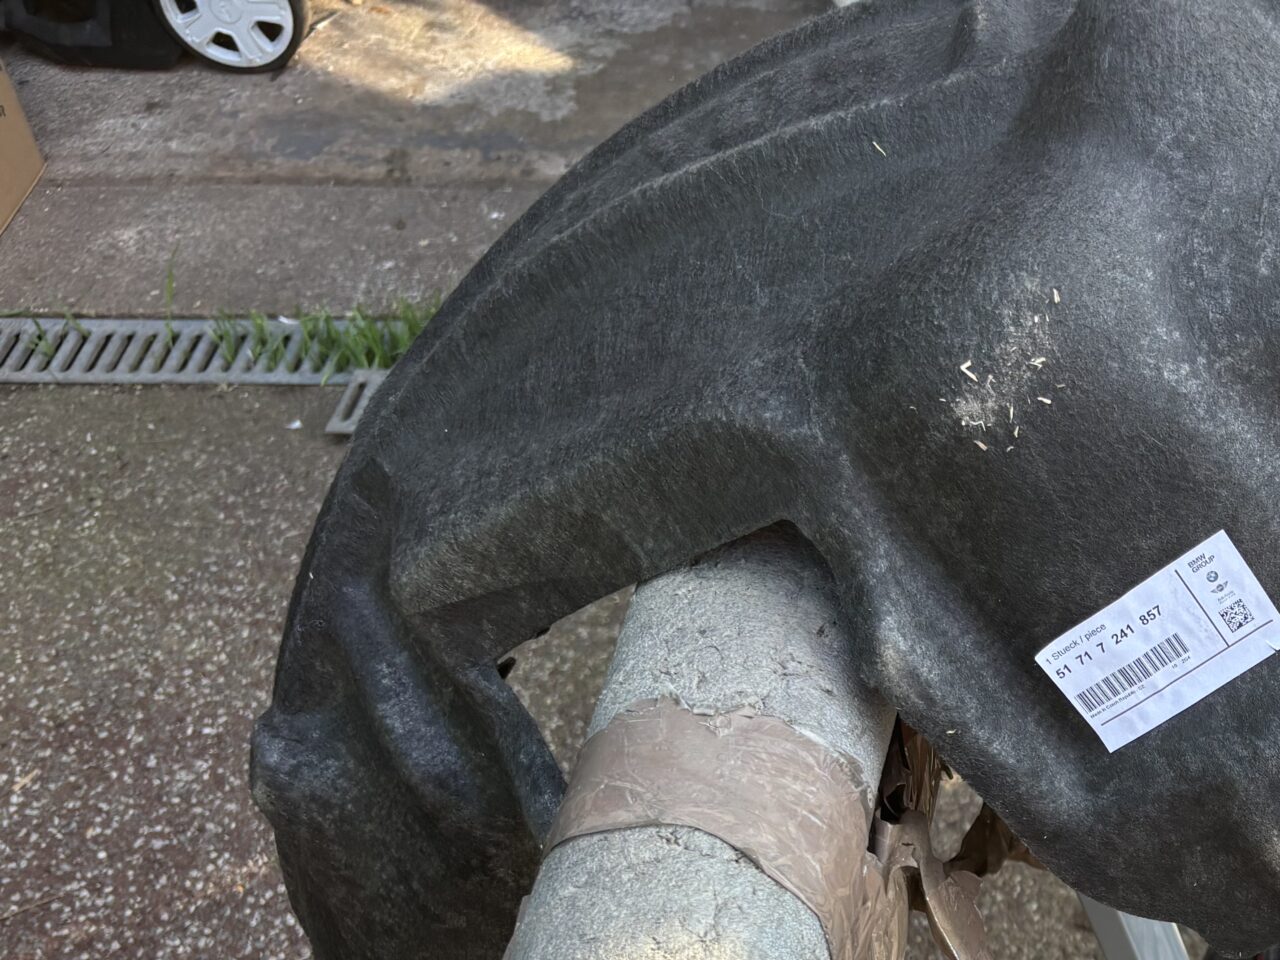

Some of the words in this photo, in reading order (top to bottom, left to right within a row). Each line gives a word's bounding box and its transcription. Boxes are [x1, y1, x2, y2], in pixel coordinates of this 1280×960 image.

[1187, 553, 1206, 568] BMW
[1191, 555, 1215, 573] GROUP
[1051, 639, 1080, 661] Stueck
[1084, 623, 1107, 642] piece
[1055, 664, 1072, 679] 51
[1075, 651, 1093, 666] 71
[1096, 642, 1106, 654] 7
[1111, 624, 1135, 645] 241
[1138, 604, 1162, 626] 857
